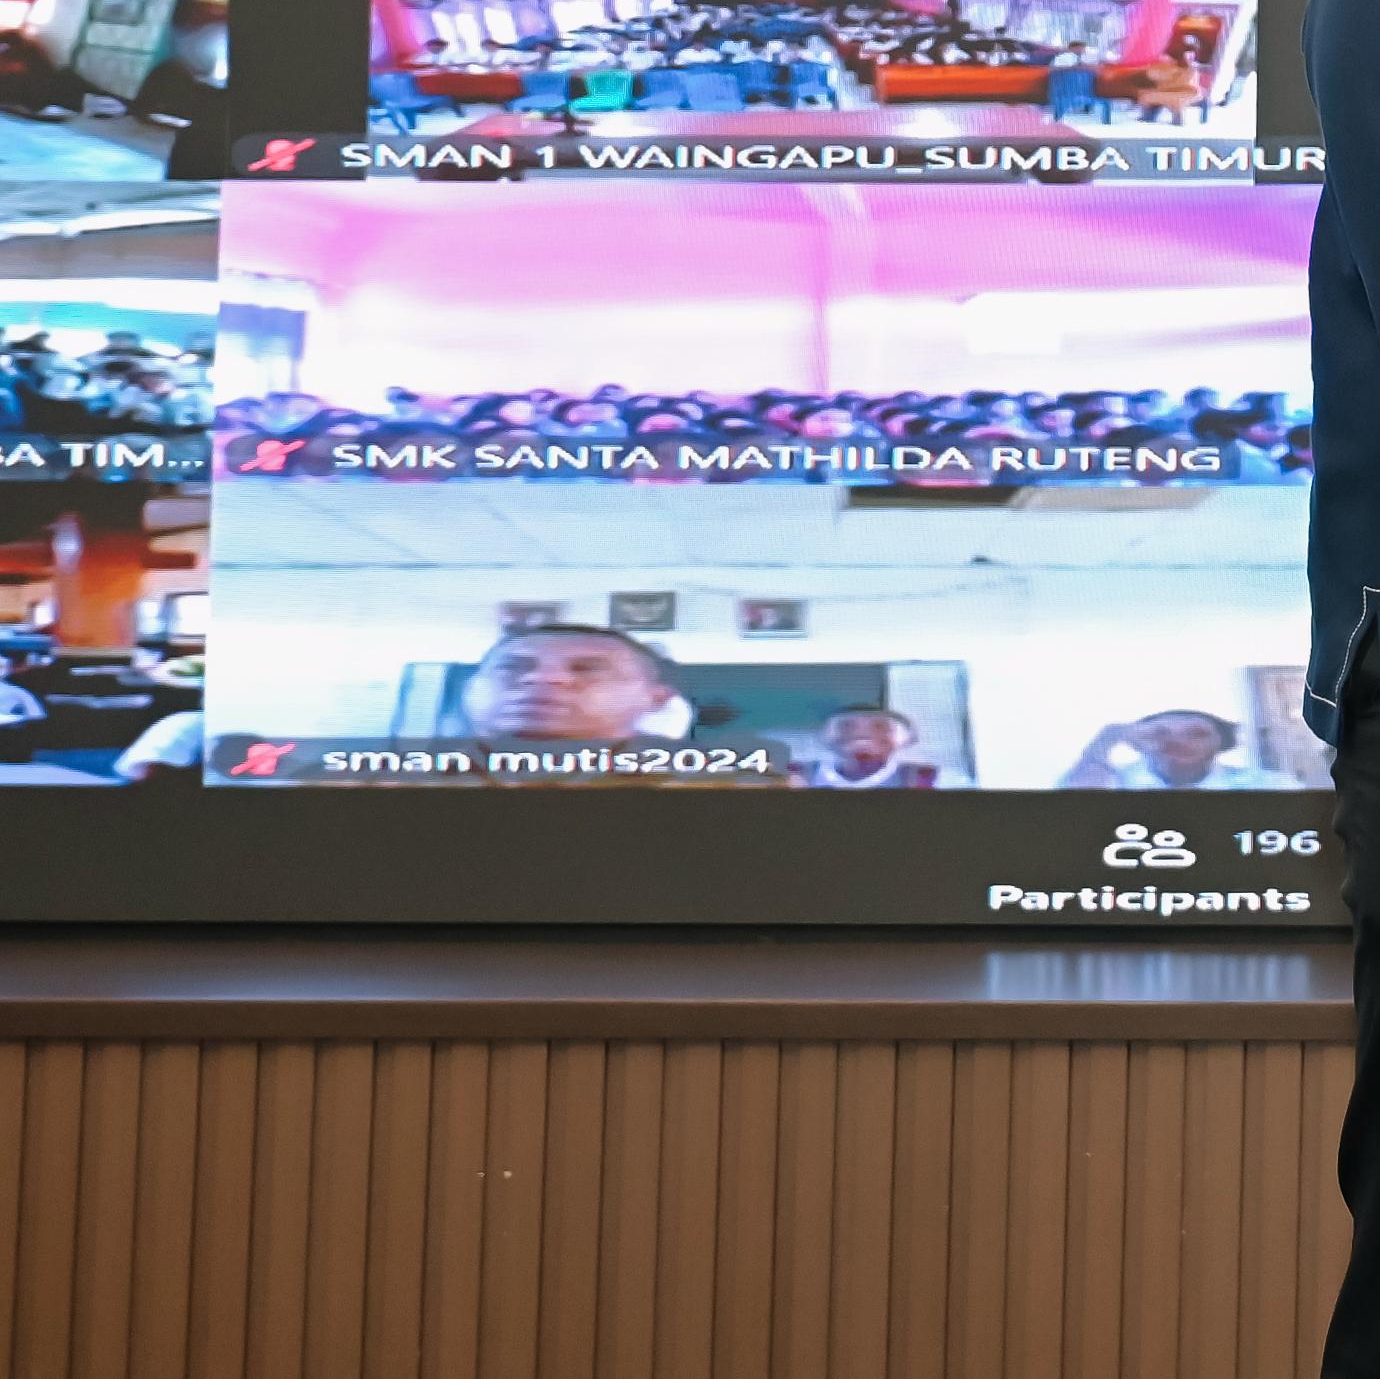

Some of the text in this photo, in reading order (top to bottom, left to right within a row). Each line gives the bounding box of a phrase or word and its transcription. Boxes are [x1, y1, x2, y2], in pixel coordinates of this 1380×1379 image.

[340, 143, 1327, 174] SMAN 1 WAINGAPU_SUMBA TIMUR
[59, 441, 205, 469] TIM...
[333, 442, 1221, 473] SMK SANTA MATHILDA RUTENG
[322, 743, 769, 779] sman mutis2024
[1233, 830, 1320, 857] 196
[989, 883, 1310, 918] Participants
